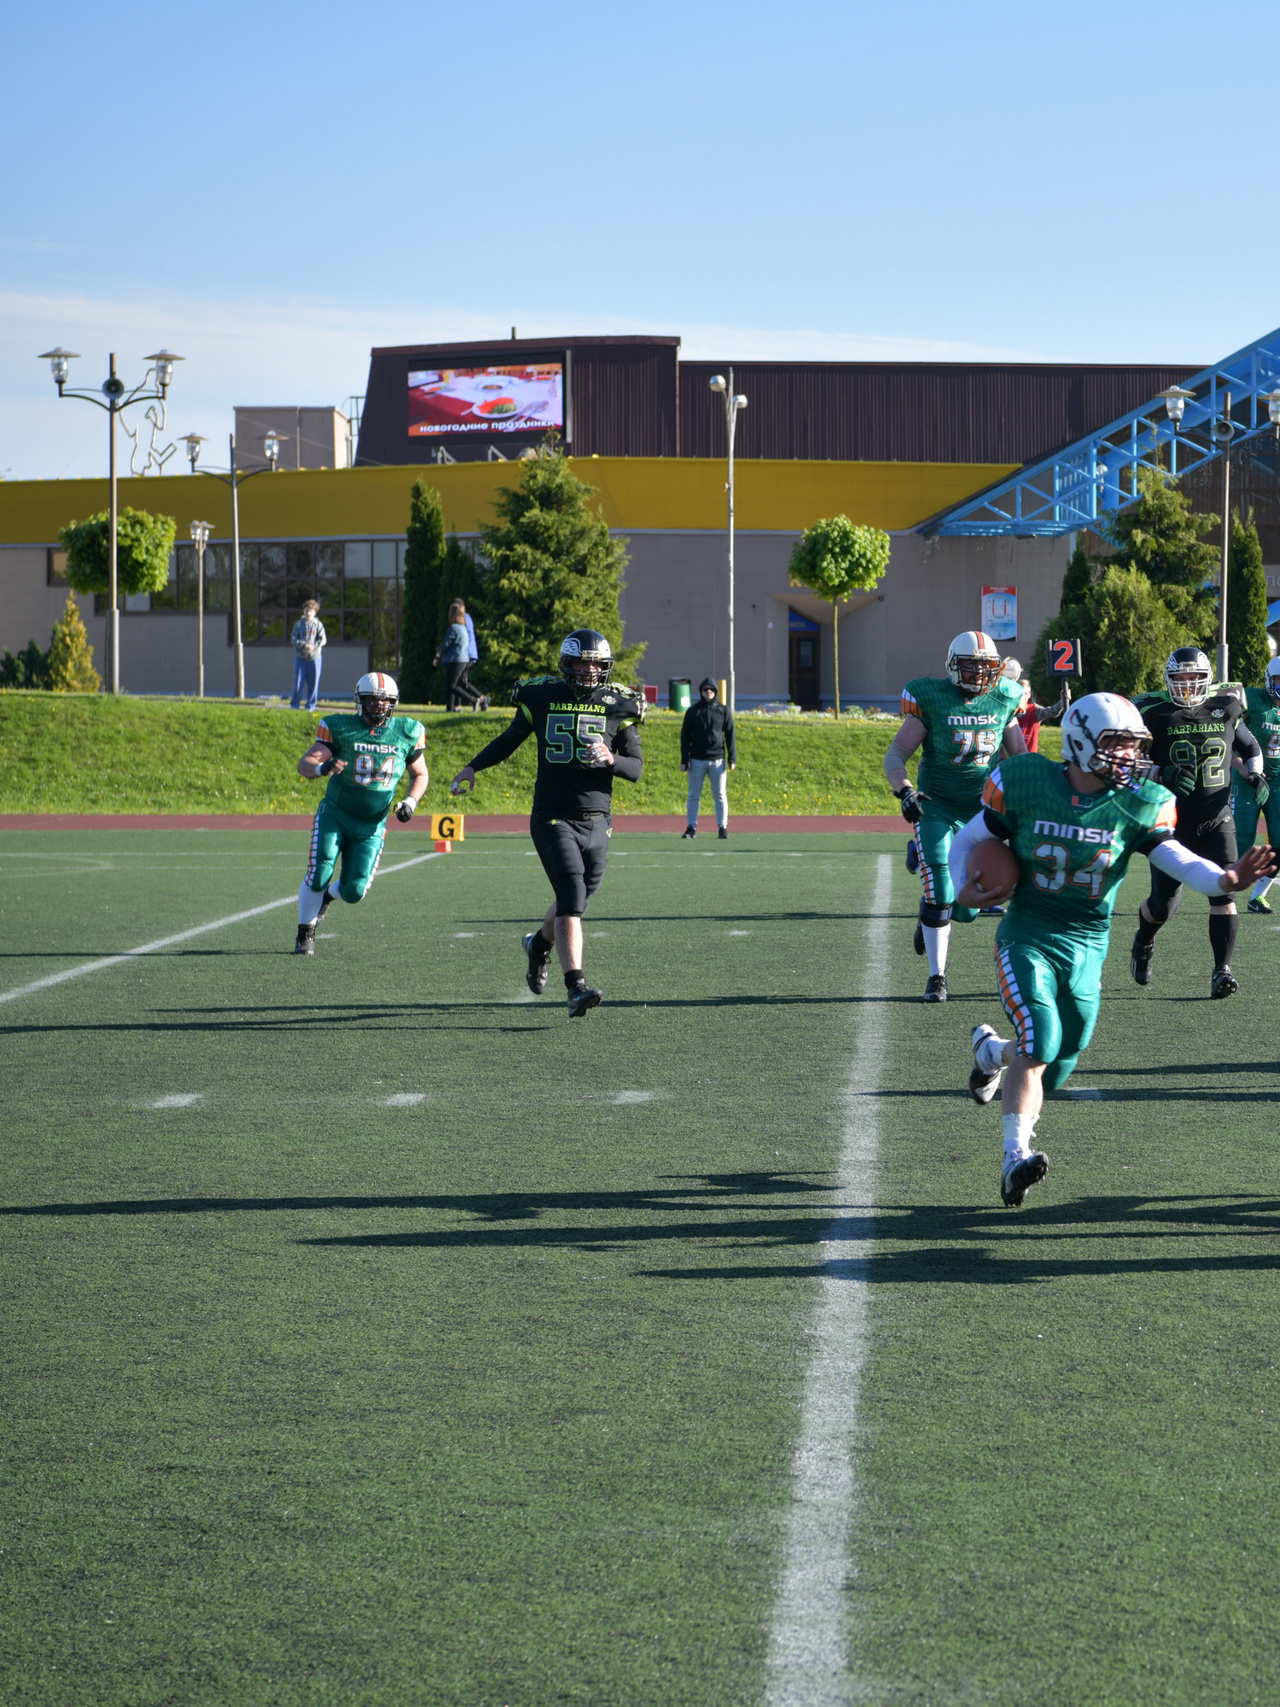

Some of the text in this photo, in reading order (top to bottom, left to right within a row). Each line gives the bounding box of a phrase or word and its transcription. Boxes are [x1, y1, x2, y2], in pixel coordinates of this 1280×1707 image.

[420, 420, 555, 433] новогодние праздники
[1053, 640, 1074, 670] 2
[549, 702, 606, 714] BARBARIANS
[545, 713, 607, 764] 55
[1167, 722, 1225, 736] BARBARIANS
[952, 729, 997, 766] 76
[353, 753, 395, 788] 94
[438, 816, 455, 838] G
[1032, 841, 1113, 900] 34
